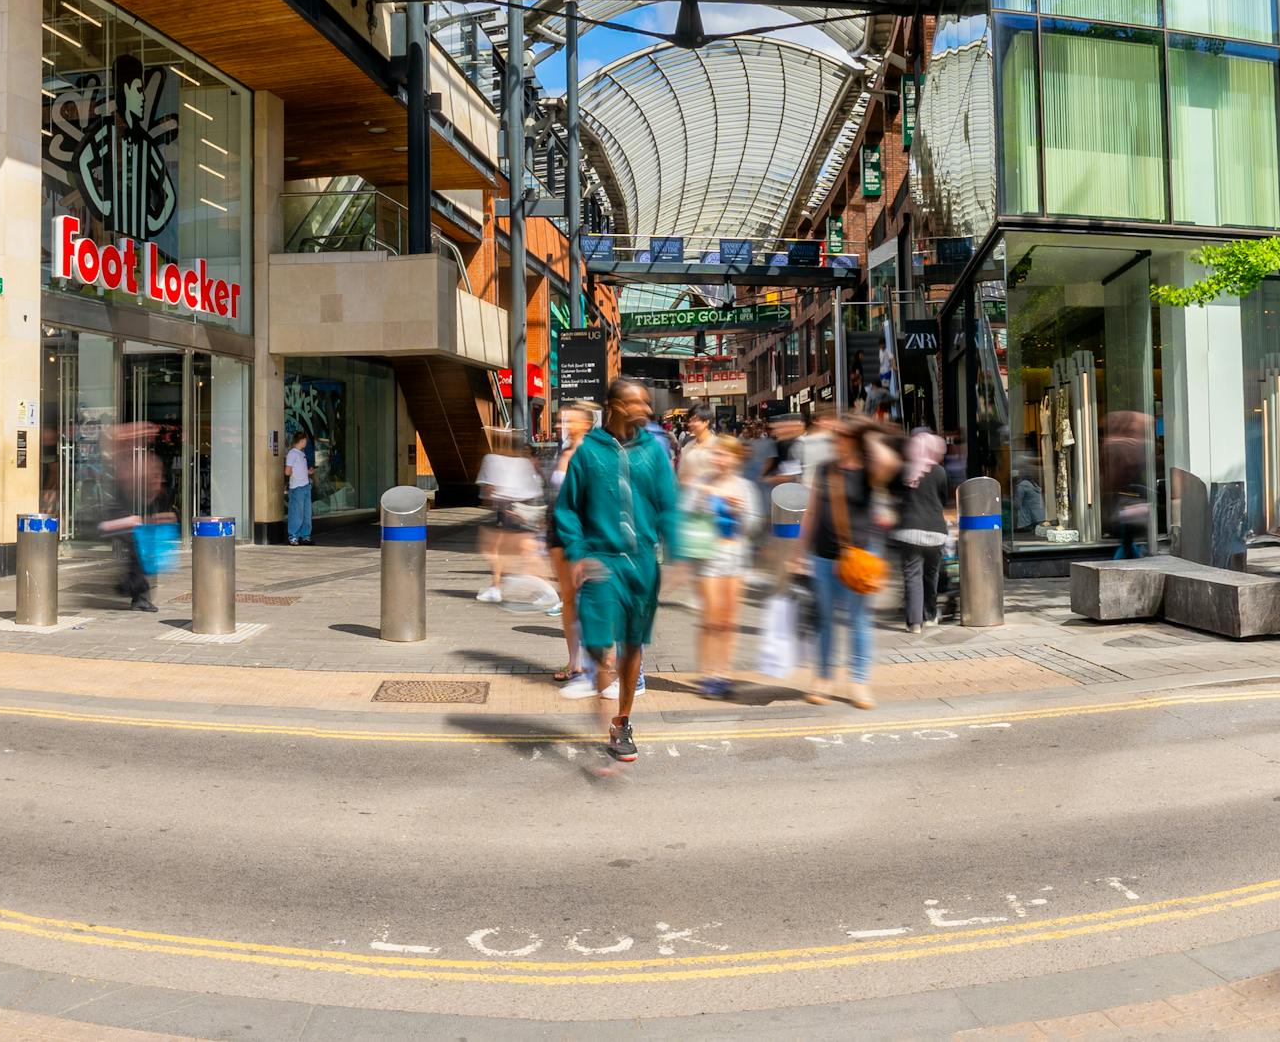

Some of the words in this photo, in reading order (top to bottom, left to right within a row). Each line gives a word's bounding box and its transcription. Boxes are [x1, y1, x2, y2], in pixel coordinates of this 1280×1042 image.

[54, 215, 138, 295] Foot
[144, 242, 241, 318] Locker
[634, 312, 695, 327] TREETOP
[698, 310, 733, 323] GOLF
[588, 331, 601, 340] UG
